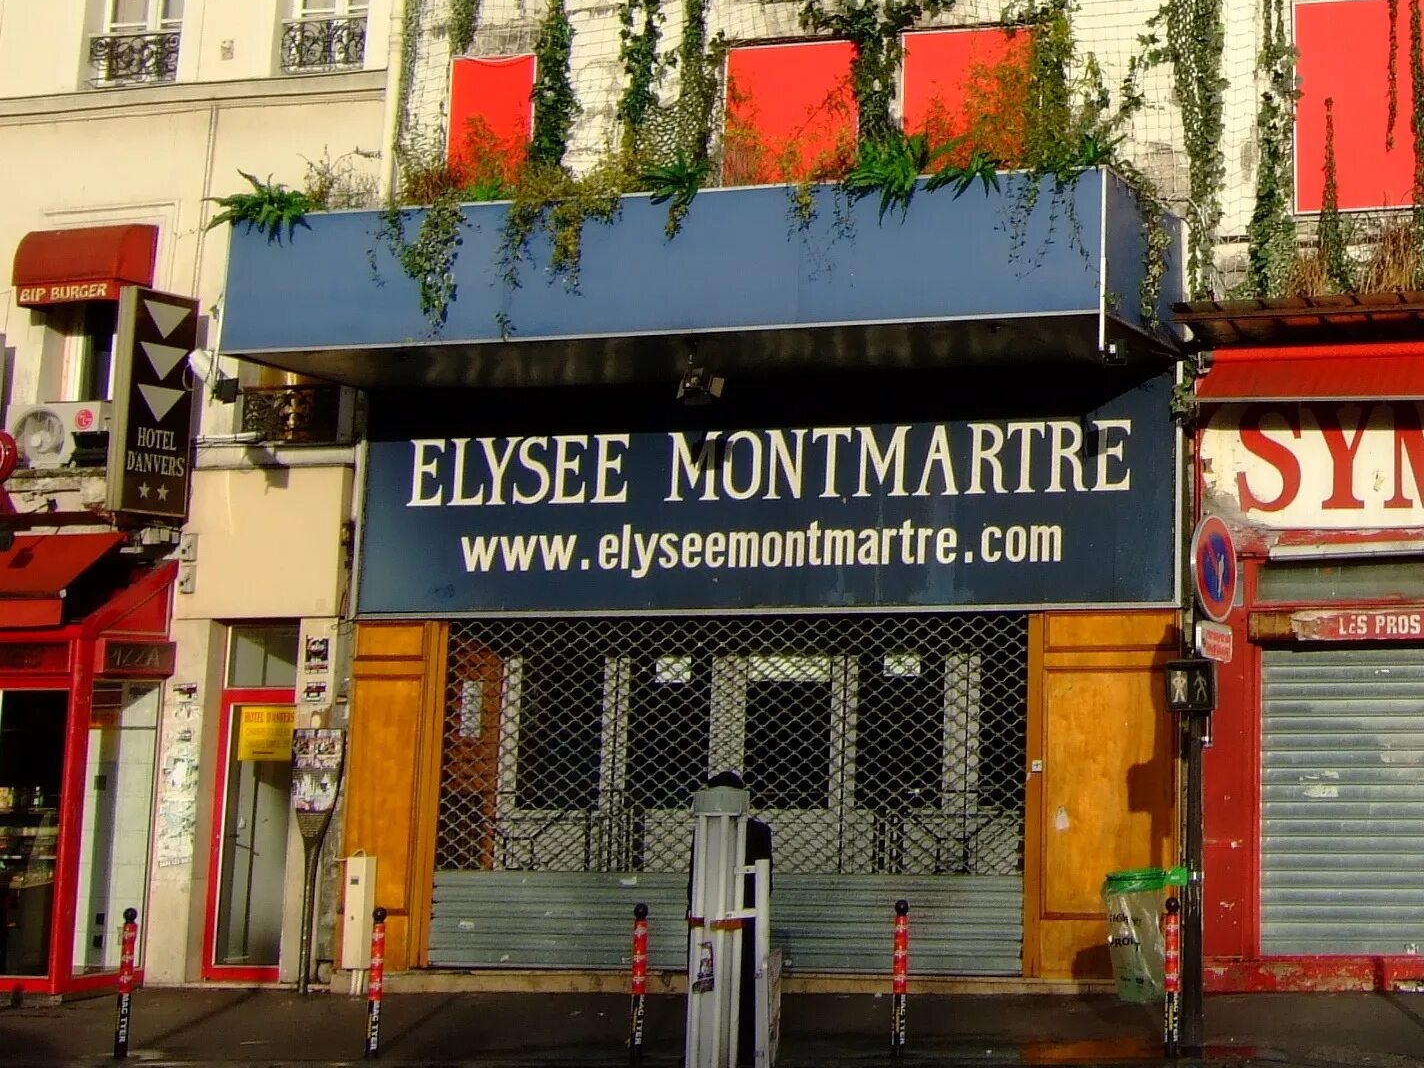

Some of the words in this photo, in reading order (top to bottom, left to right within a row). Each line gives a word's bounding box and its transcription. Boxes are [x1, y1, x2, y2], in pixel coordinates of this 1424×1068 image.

[19, 287, 46, 302] BIP
[50, 283, 108, 300] BURGER
[137, 426, 177, 451] HOTEL
[126, 450, 186, 477] D'ANVERS
[405, 433, 631, 508] ELYSEE
[663, 418, 1132, 502] MONTMARTRE
[460, 518, 1063, 578] www.elyseemontmartre.com
[1375, 614, 1421, 634] PROS
[121, 993, 130, 1015] MAC
[118, 1016, 129, 1044] TYER
[370, 1022, 380, 1051] TYER
